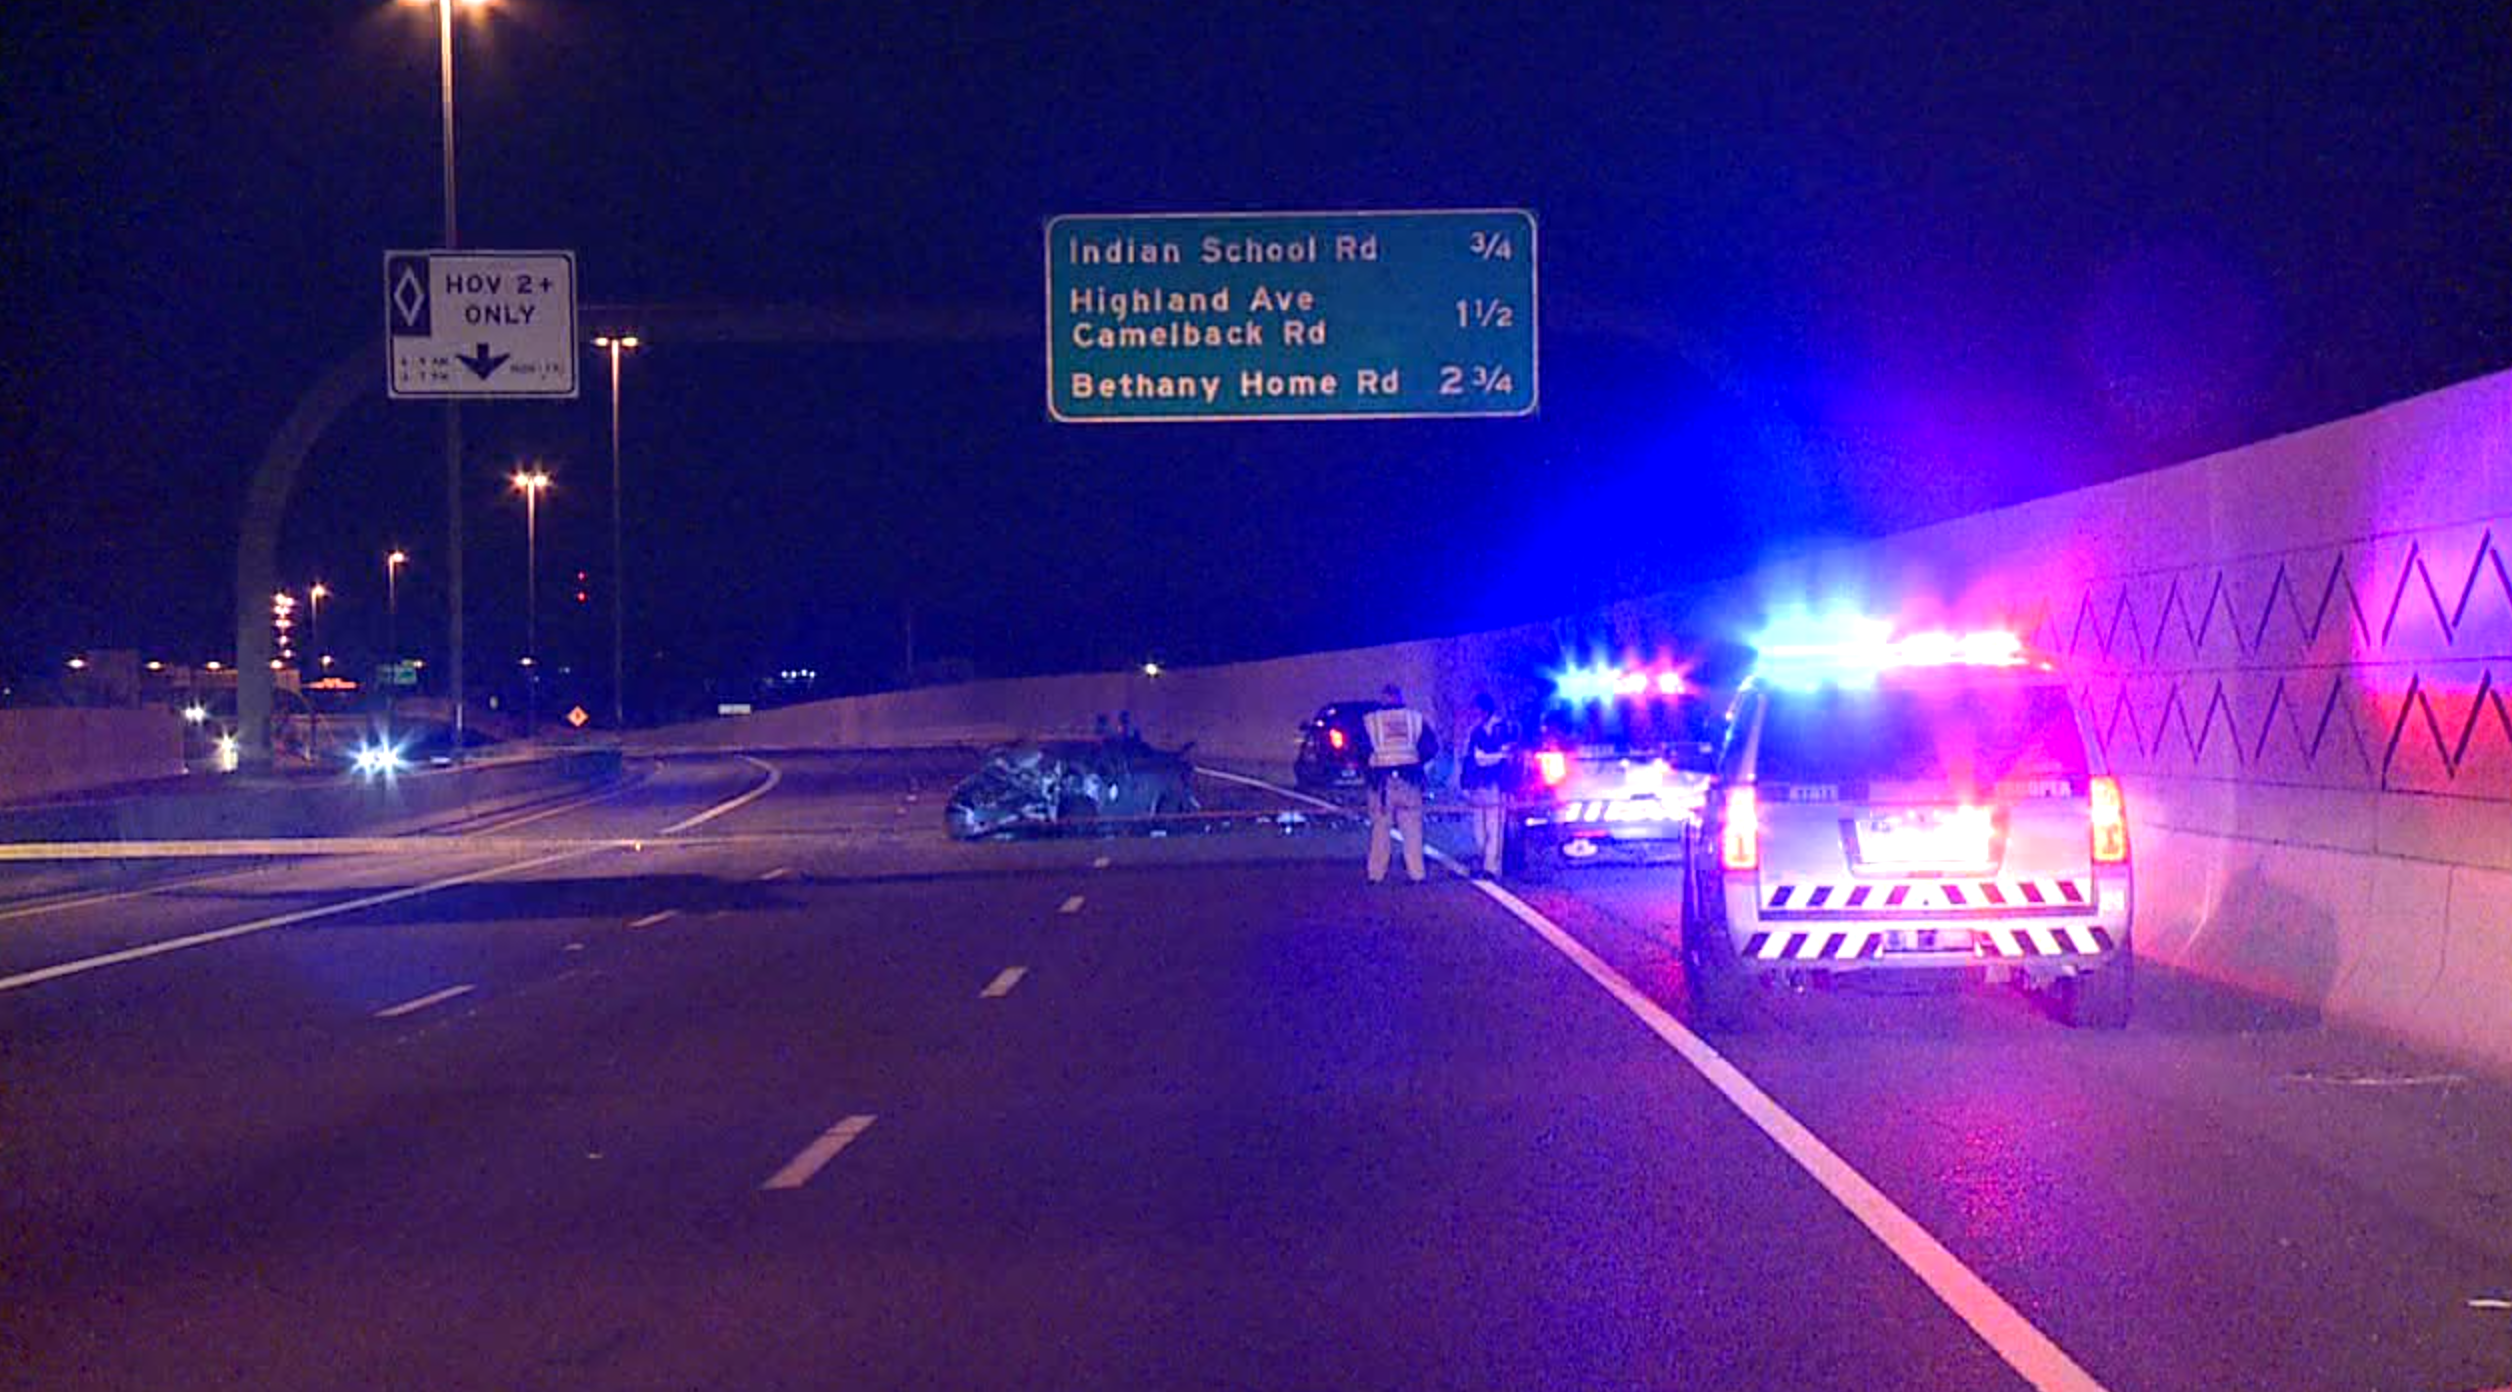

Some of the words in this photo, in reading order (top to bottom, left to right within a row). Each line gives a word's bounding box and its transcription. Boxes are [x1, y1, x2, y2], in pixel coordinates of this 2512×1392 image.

[1069, 236, 1181, 263] Indian
[1202, 235, 1317, 263] School
[1335, 234, 1378, 262] Rd
[446, 274, 501, 294] HOV
[465, 305, 535, 325] ONLY
[1069, 286, 1230, 321] Highland
[1250, 285, 1315, 312] Ave
[1072, 320, 1263, 347] Camelback
[1283, 319, 1327, 345] Rd
[1071, 371, 1221, 402] Bethany
[1240, 369, 1338, 397] Home
[1357, 368, 1400, 395] Rd
